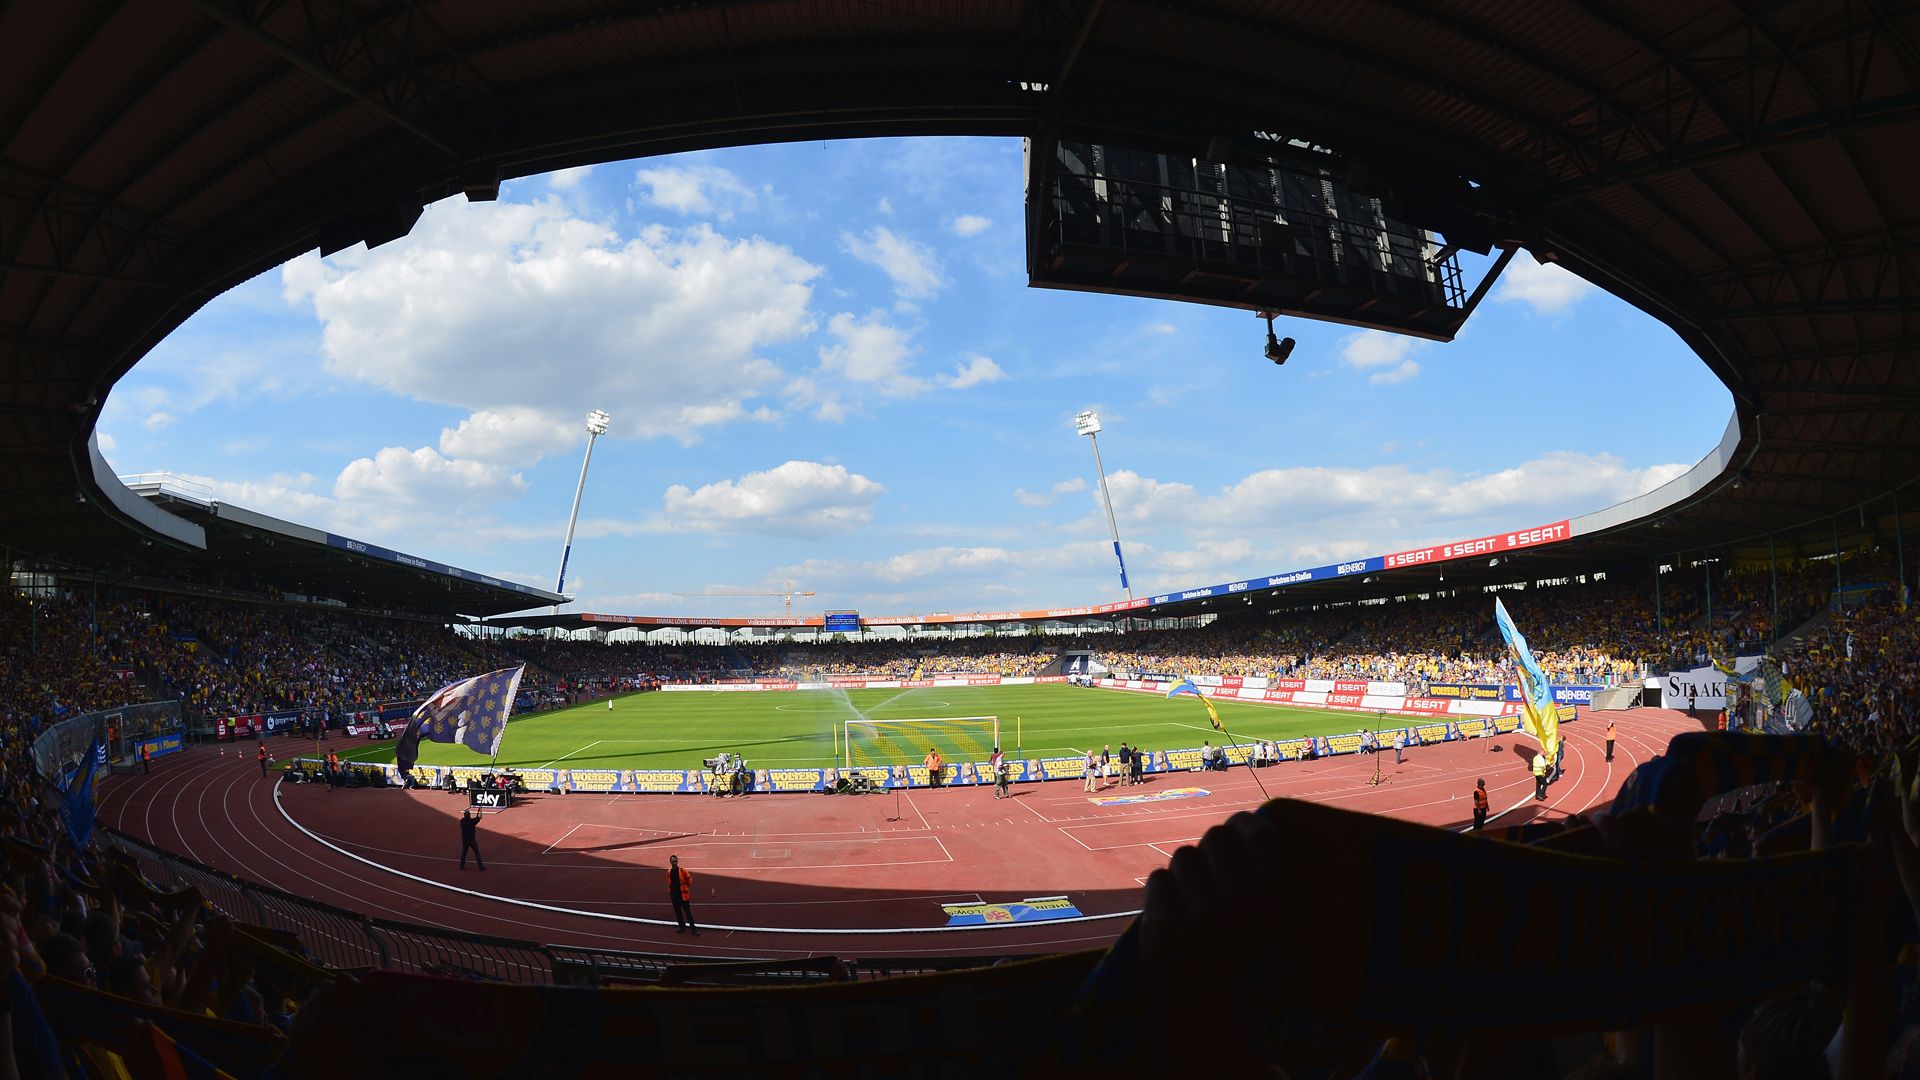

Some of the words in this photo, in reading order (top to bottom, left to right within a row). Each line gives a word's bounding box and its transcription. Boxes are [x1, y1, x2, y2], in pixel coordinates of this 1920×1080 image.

[1519, 526, 1564, 544] SEAT
[1454, 539, 1496, 555] SEAT
[1398, 550, 1433, 565] SEAT
[1295, 572, 1312, 581] Stadion
[1430, 687, 1459, 696] WOLTERS
[1334, 695, 1360, 704] SEAT
[1414, 700, 1446, 710] SEAT
[571, 772, 617, 783] WOLTERS
[636, 772, 683, 783] WOLTERS
[770, 771, 821, 783] WOLTERS
[576, 782, 613, 790] Pilsener
[775, 782, 816, 790] Pilsener
[477, 791, 499, 806] sky
[1397, 856, 1840, 974] BRAUNSCHWEIG
